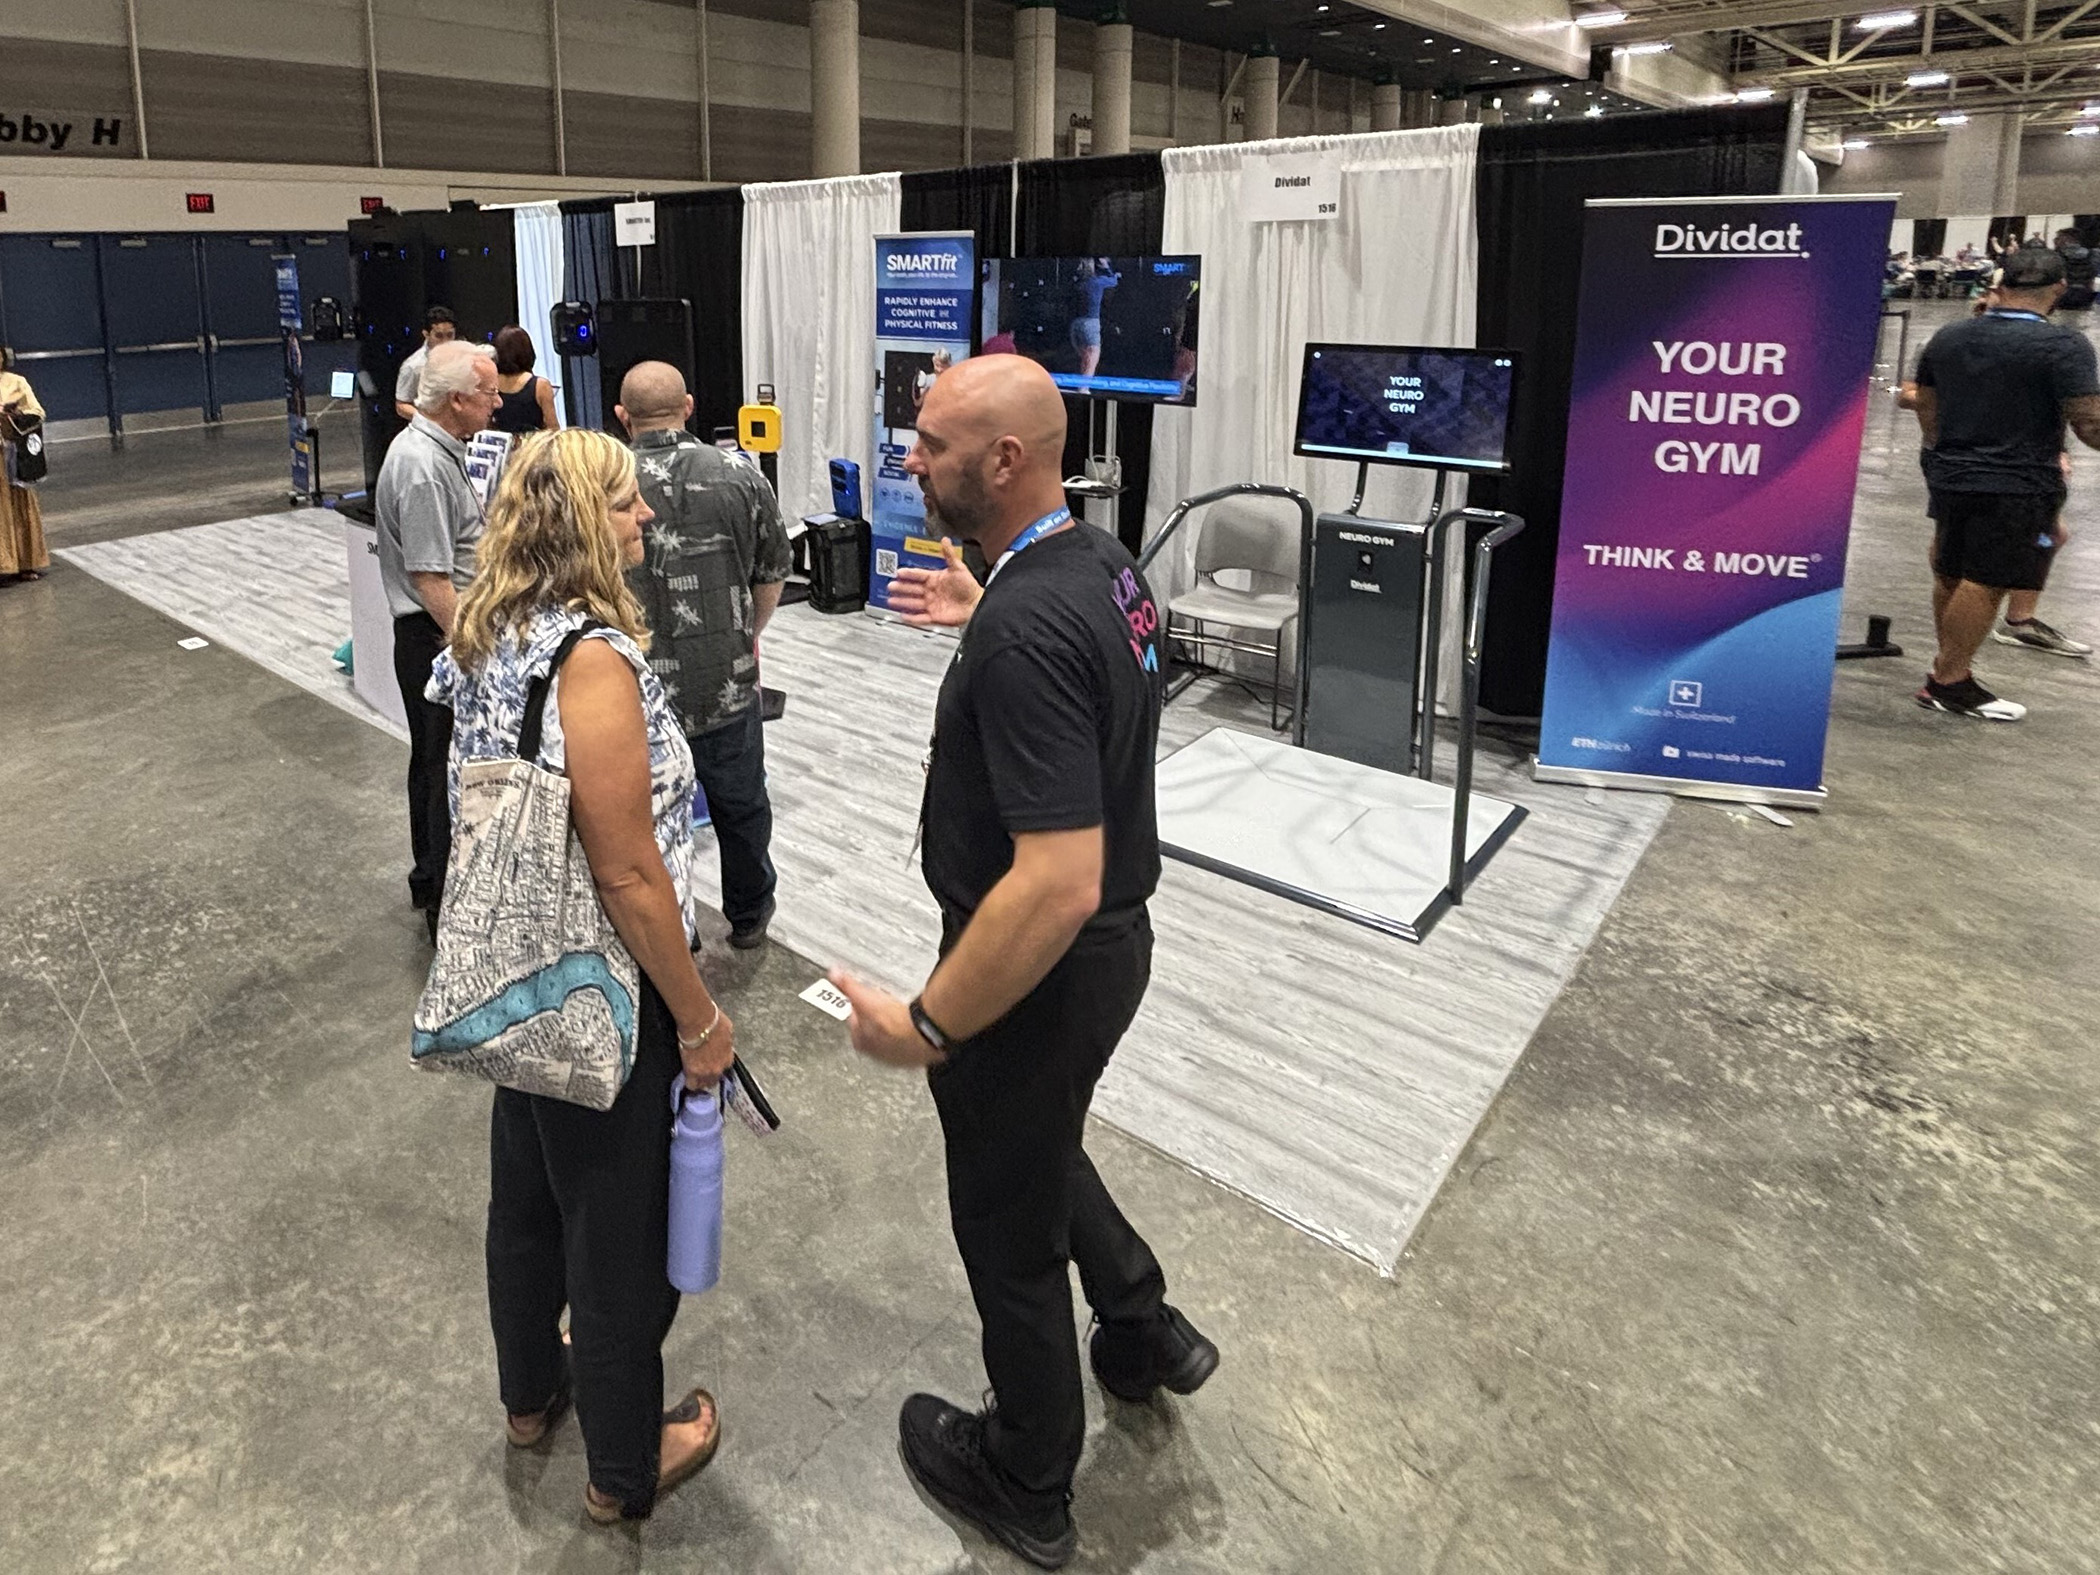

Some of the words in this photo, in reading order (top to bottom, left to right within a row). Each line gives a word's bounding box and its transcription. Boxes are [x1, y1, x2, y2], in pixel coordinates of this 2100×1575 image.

[92, 118, 120, 145] H
[1275, 176, 1310, 188] Dividat
[190, 196, 210, 210] EXIT
[1318, 203, 1336, 213] 1516
[884, 297, 917, 306] RAPIDLY
[920, 298, 958, 307] ENHANCE
[891, 308, 936, 318] COGNITIVE
[885, 320, 923, 329] PHYSICAL
[925, 321, 958, 330] FITNESS
[1653, 341, 1787, 376] YOUR
[1389, 376, 1421, 388] YOUR
[1383, 389, 1424, 401] NEURO
[1389, 402, 1416, 414] GYM
[1628, 390, 1801, 428] NEURO
[1654, 440, 1762, 476] GYM
[1339, 531, 1371, 543] NEURO
[1372, 536, 1395, 547] GYM
[1583, 544, 1675, 570] THINK
[1682, 550, 1706, 573] &
[816, 988, 851, 1009] 1516
